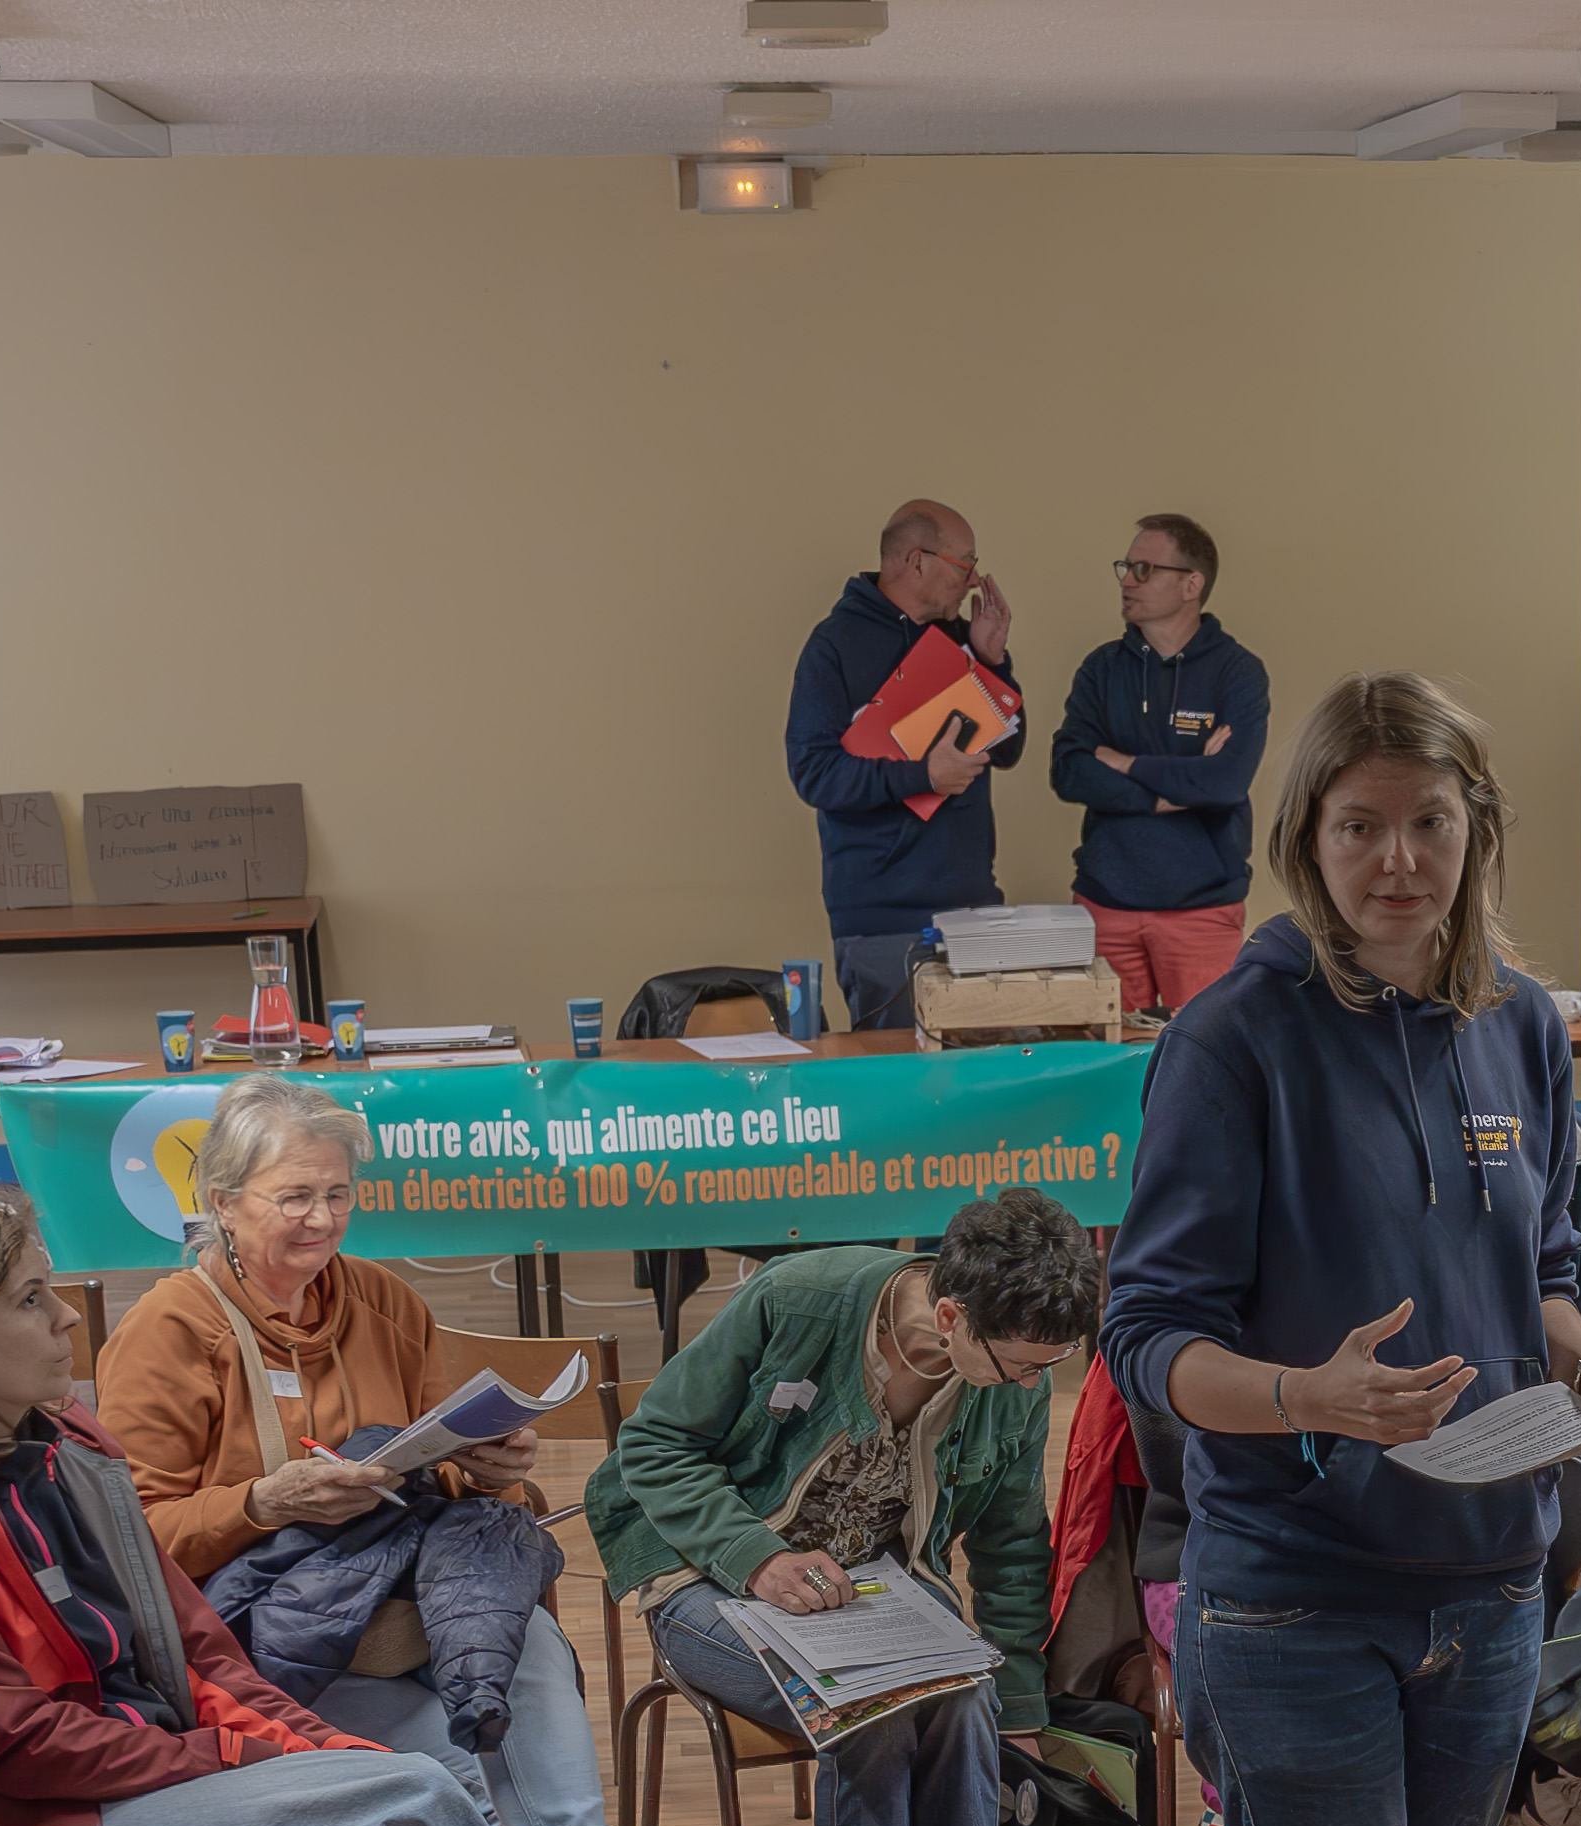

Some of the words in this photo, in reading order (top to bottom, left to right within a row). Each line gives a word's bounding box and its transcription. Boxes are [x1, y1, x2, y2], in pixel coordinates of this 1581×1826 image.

[379, 1119, 461, 1158] votre
[469, 1109, 539, 1160] avis,
[547, 1108, 593, 1167] qui
[600, 1106, 734, 1155] alimente
[742, 1107, 777, 1146] ce
[783, 1097, 840, 1144] lieu
[357, 1179, 395, 1211] en
[403, 1166, 566, 1211] électricité
[573, 1163, 628, 1207] 100
[635, 1161, 677, 1206] %
[685, 1150, 876, 1203] renouvelable
[884, 1154, 915, 1191] et
[923, 1136, 1096, 1196] coopérative
[1101, 1132, 1120, 1178] ?
